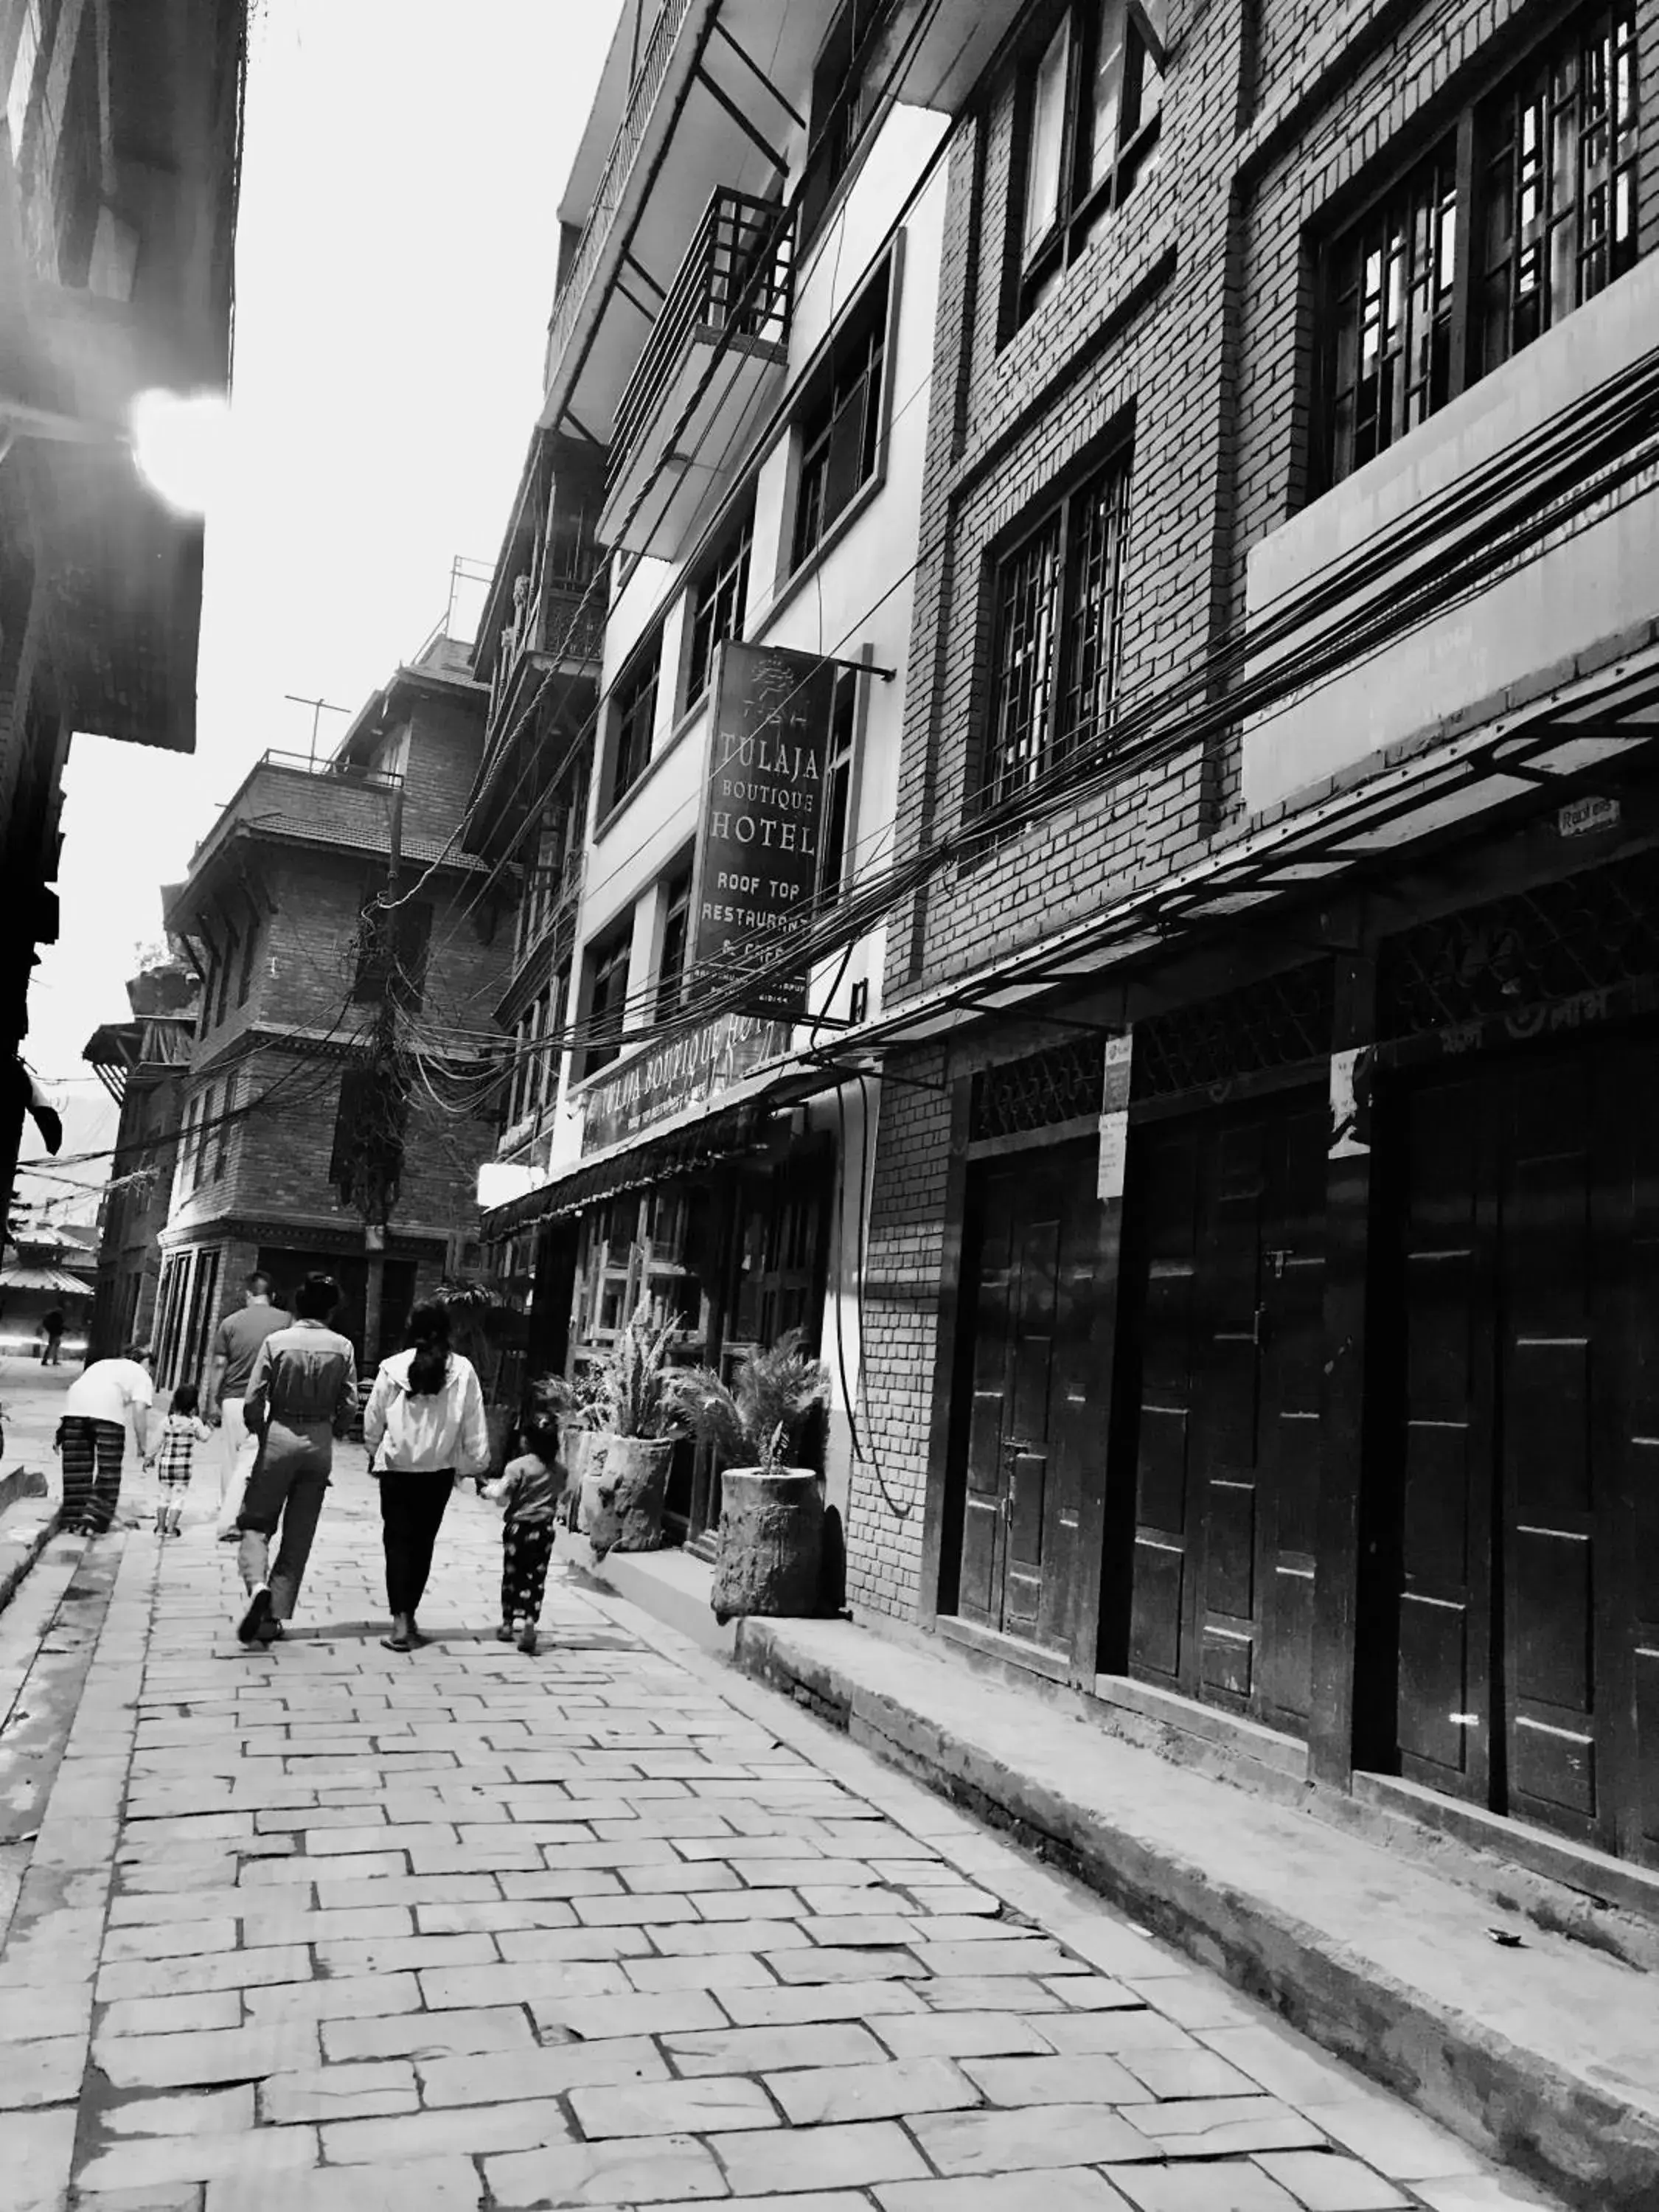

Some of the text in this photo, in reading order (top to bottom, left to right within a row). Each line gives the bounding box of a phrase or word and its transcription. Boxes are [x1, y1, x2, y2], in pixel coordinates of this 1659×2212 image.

[719, 732, 819, 781] TULAJA
[723, 779, 814, 812] BOUTIQUE
[710, 811, 815, 856] HOTEL
[717, 872, 800, 901] ROOF TOP
